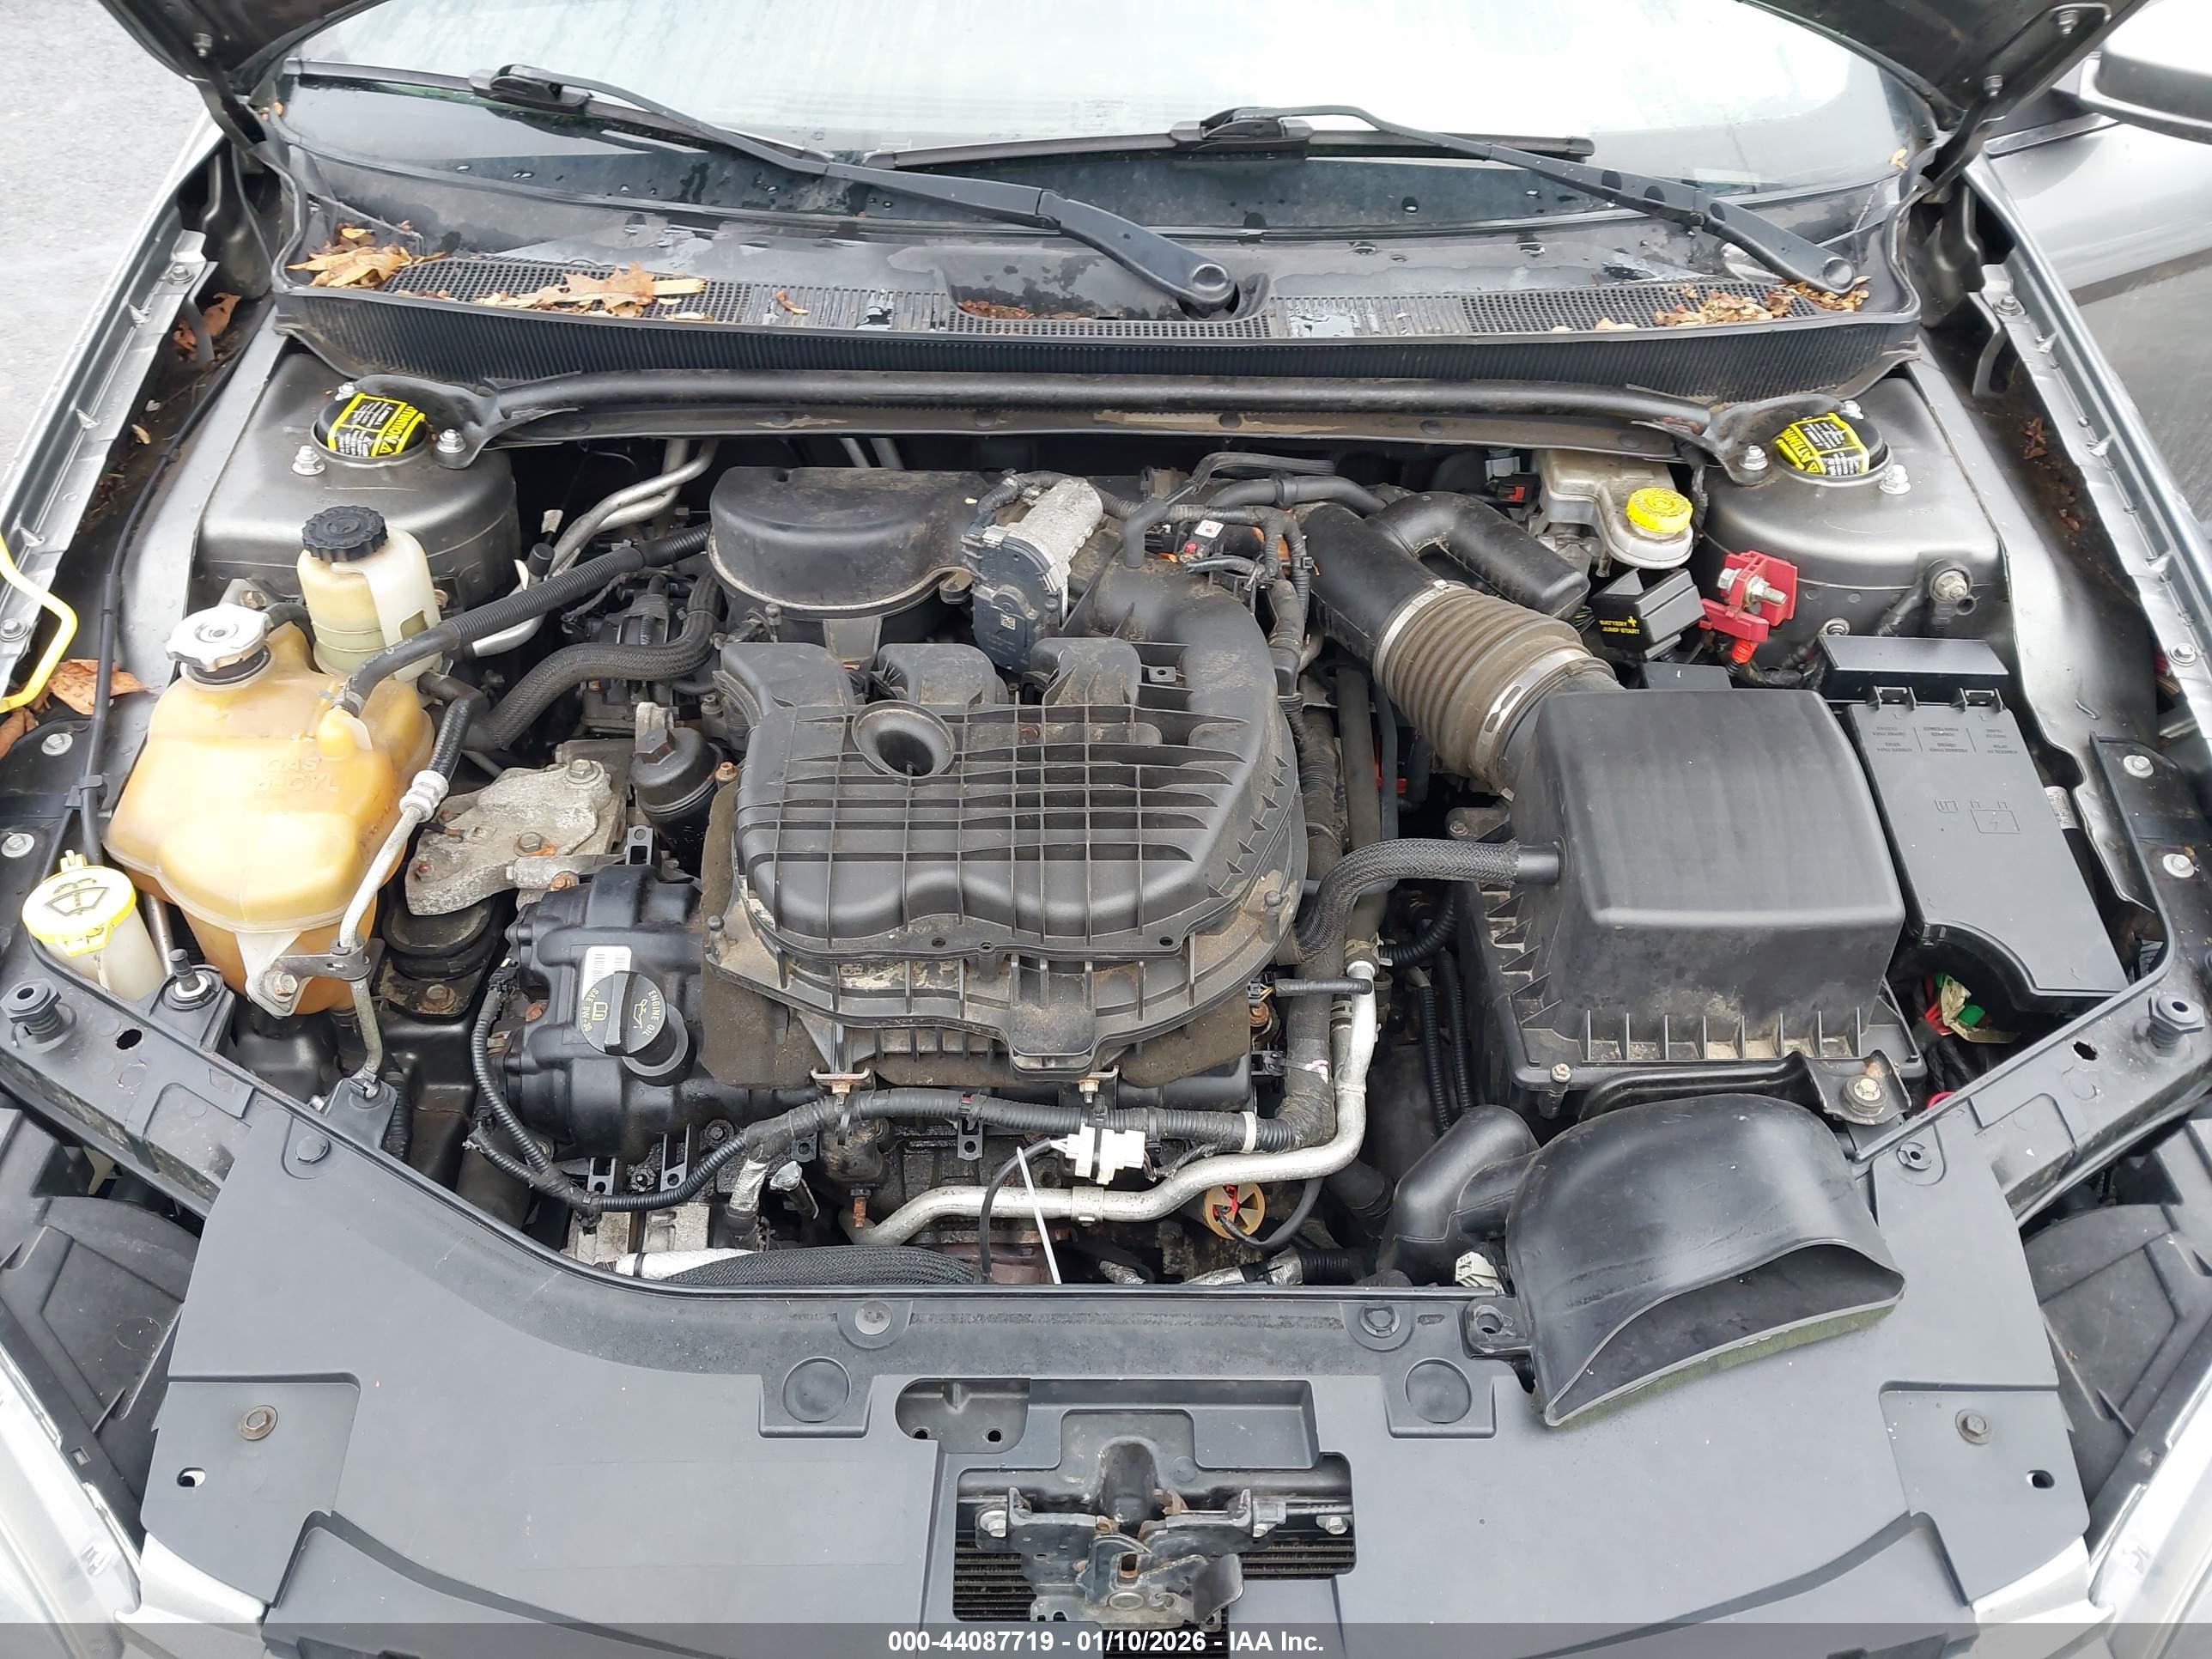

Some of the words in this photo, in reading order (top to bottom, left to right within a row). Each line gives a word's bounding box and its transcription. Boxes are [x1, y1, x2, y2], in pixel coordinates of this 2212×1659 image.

[585, 988, 599, 1004] SAE
[647, 988, 660, 1022] ENGINE
[581, 1006, 593, 1032] 5W-30
[641, 1024, 655, 1036] OIL
